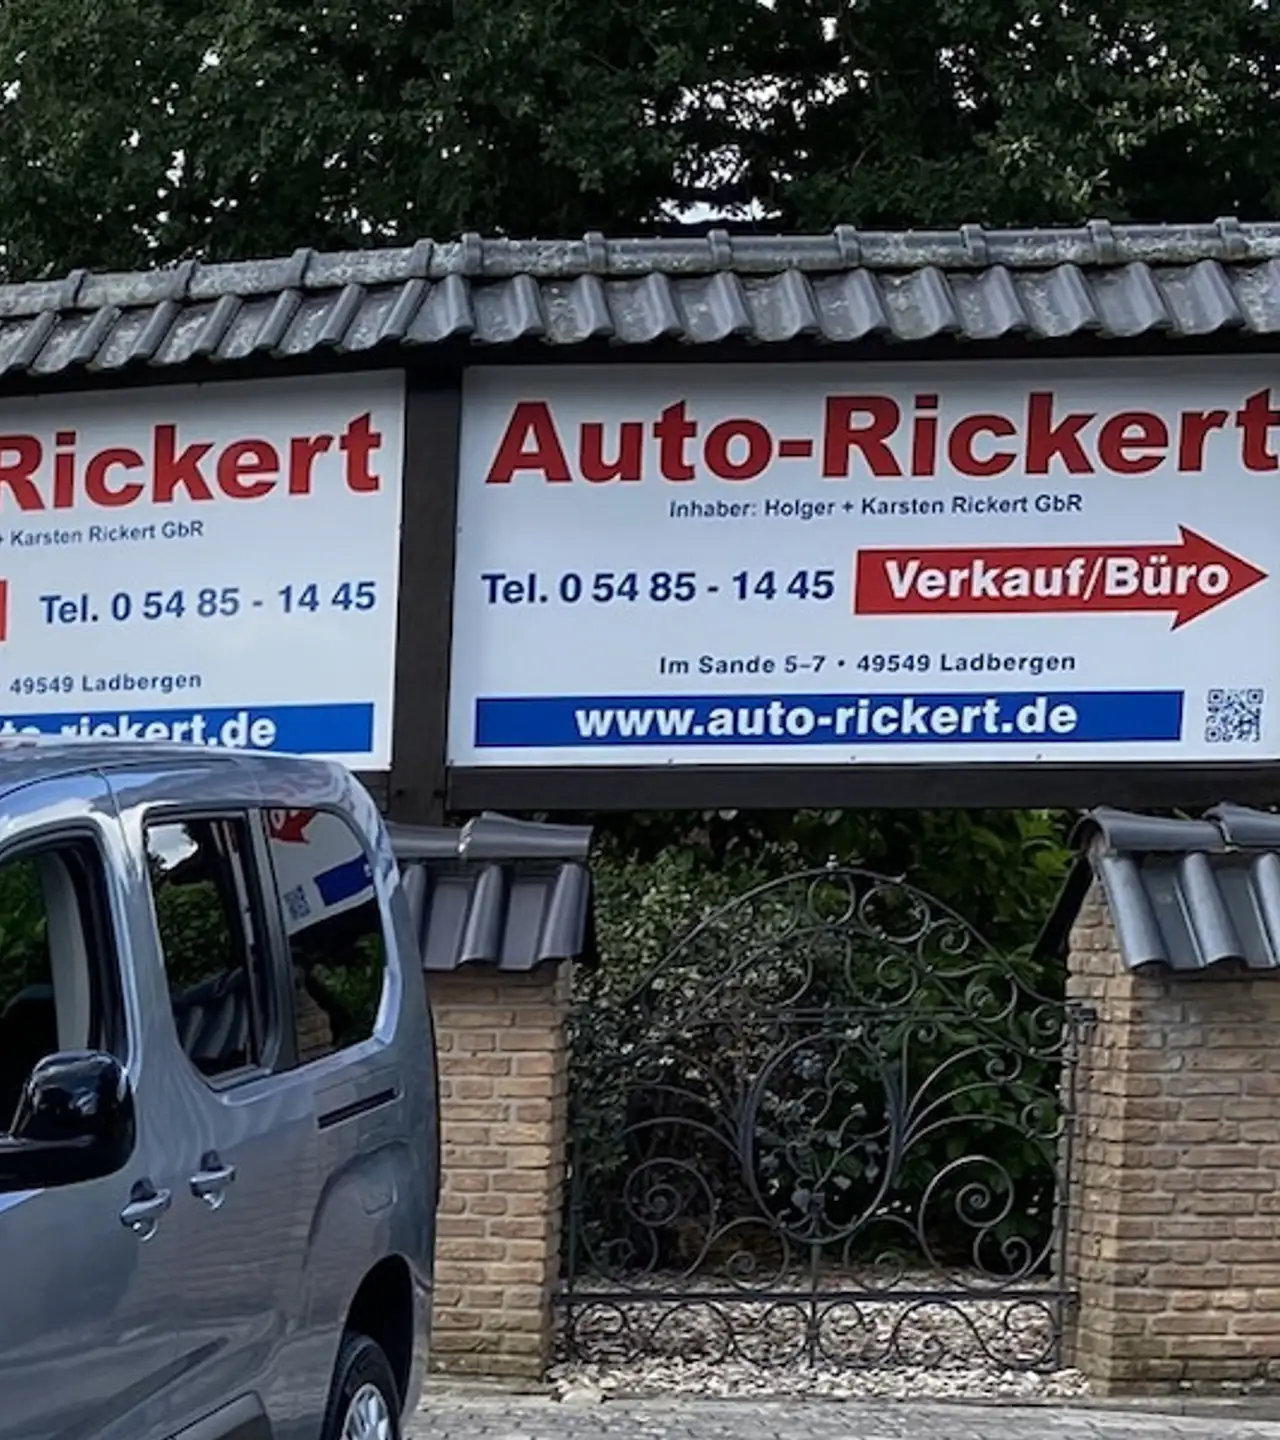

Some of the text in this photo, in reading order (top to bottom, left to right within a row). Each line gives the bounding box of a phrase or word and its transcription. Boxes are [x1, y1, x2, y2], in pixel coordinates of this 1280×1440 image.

[485, 387, 1280, 485] Auto-Rickert
[669, 499, 757, 519] Inhaber:
[764, 498, 836, 521] Holger
[860, 496, 945, 516] Karsten
[951, 494, 1029, 514] Rickert
[1034, 493, 1084, 513] GbR
[10, 528, 83, 547] Karsten
[88, 524, 157, 544] Rickert
[160, 520, 205, 539] GbR
[480, 572, 549, 605] Tel.
[590, 572, 641, 603] 54
[647, 571, 698, 602] 85
[731, 570, 777, 601] 14
[785, 570, 836, 601] 45
[885, 554, 1230, 600] Verkauf/Büro
[38, 592, 100, 625] Tel.
[141, 589, 187, 621] 54
[196, 586, 241, 619] 85
[277, 583, 321, 614] 14
[330, 580, 377, 612] 45
[659, 650, 1077, 677] Im Sande 5-7 49549 Ladbergen
[9, 675, 75, 696] 49549
[81, 671, 203, 696] Ladbergen
[574, 697, 1078, 738] www.auto-rickert.de
